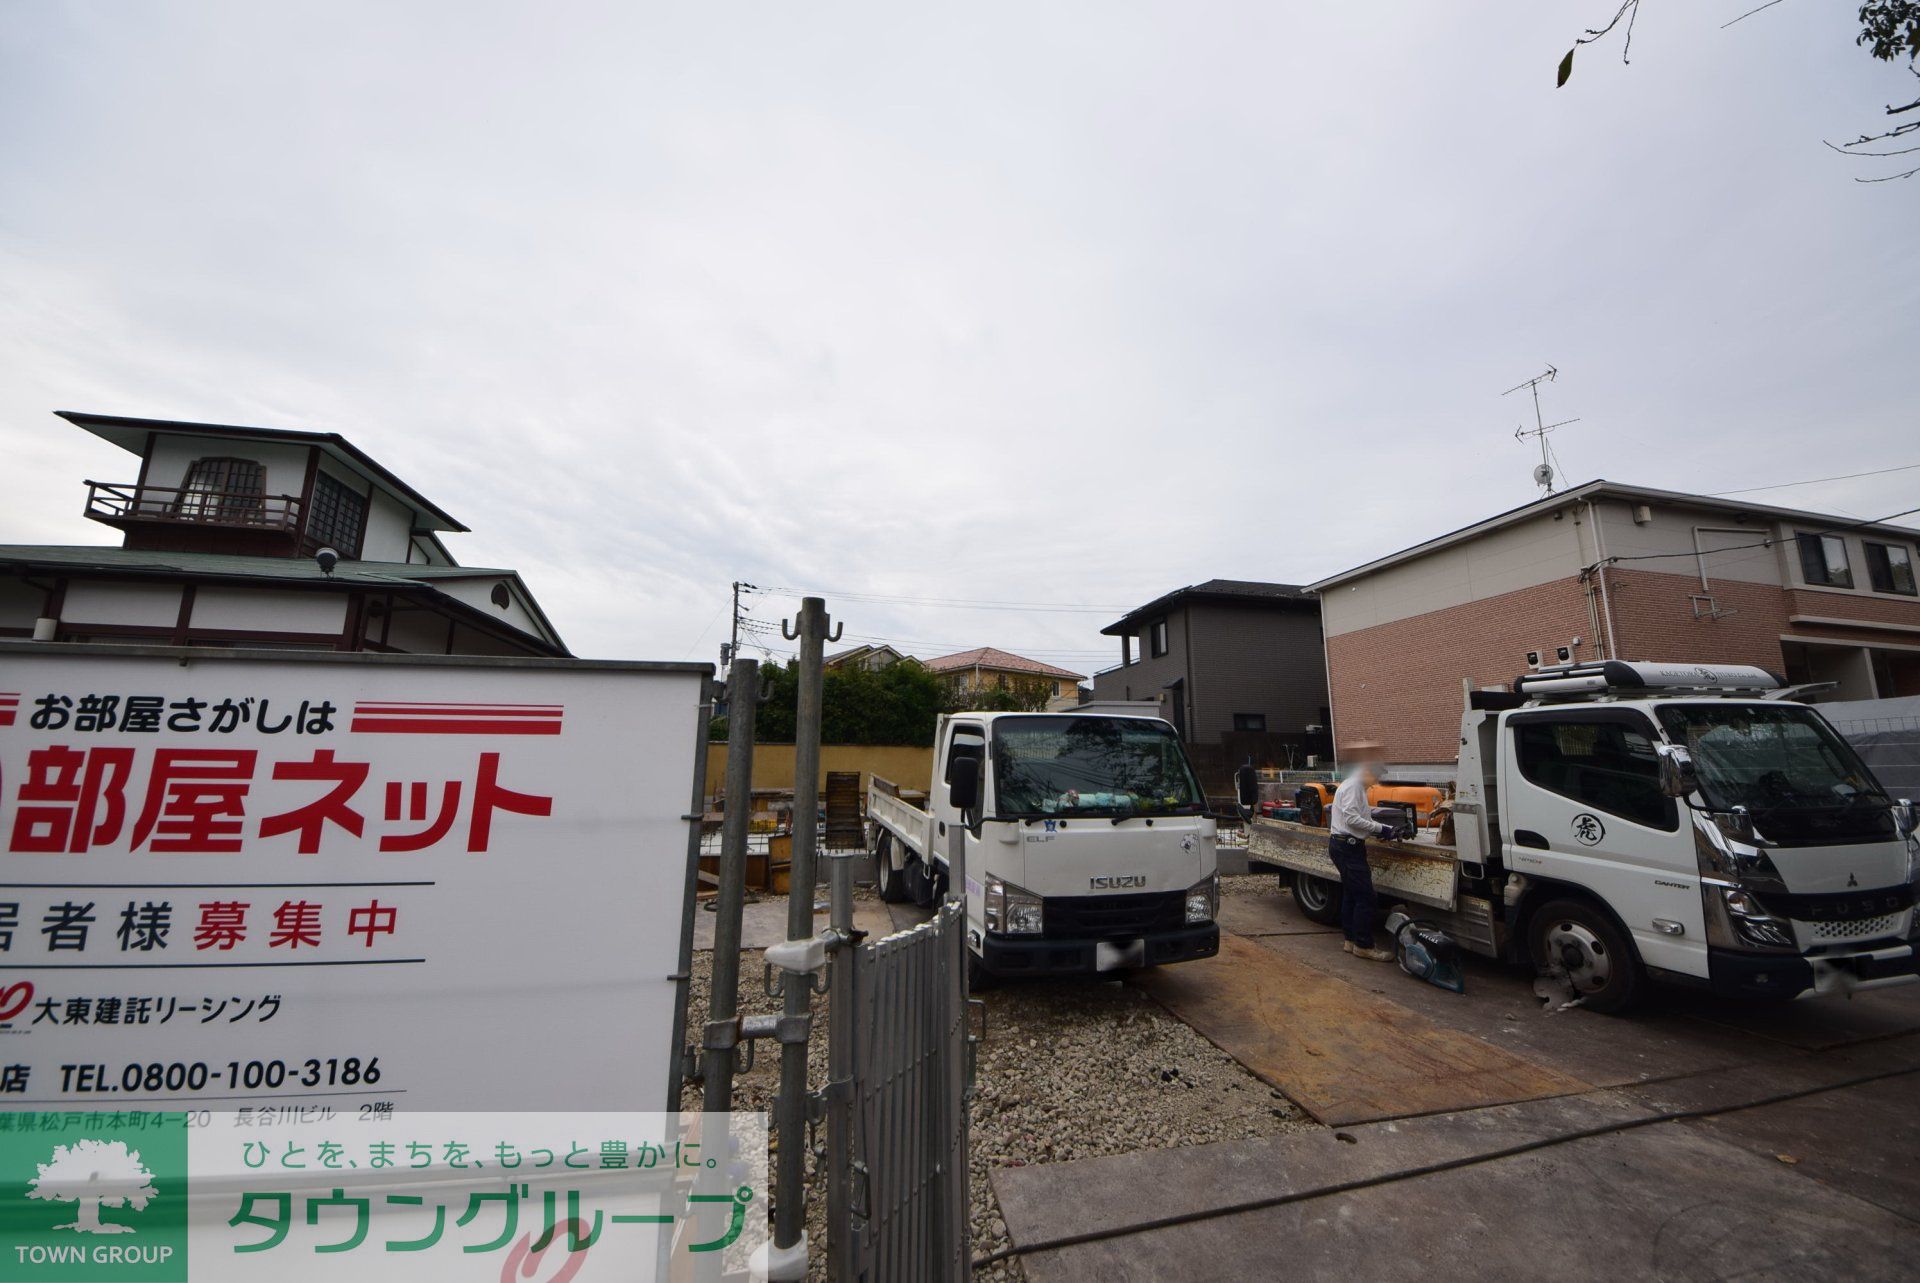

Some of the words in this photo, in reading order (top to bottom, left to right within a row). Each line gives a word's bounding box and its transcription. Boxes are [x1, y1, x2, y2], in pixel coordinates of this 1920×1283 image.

[30, 693, 337, 735] お部屋さがしは
[0, 745, 553, 855] 部屋ネット
[1026, 835, 1055, 843] ELF
[1089, 875, 1147, 890] ISUZU
[31, 994, 282, 1026] 大東建託リーシング
[60, 1057, 382, 1093] TEL.0800-100-3186
[233, 1105, 337, 1128] 長谷川ビル
[358, 1101, 394, 1122] 2階
